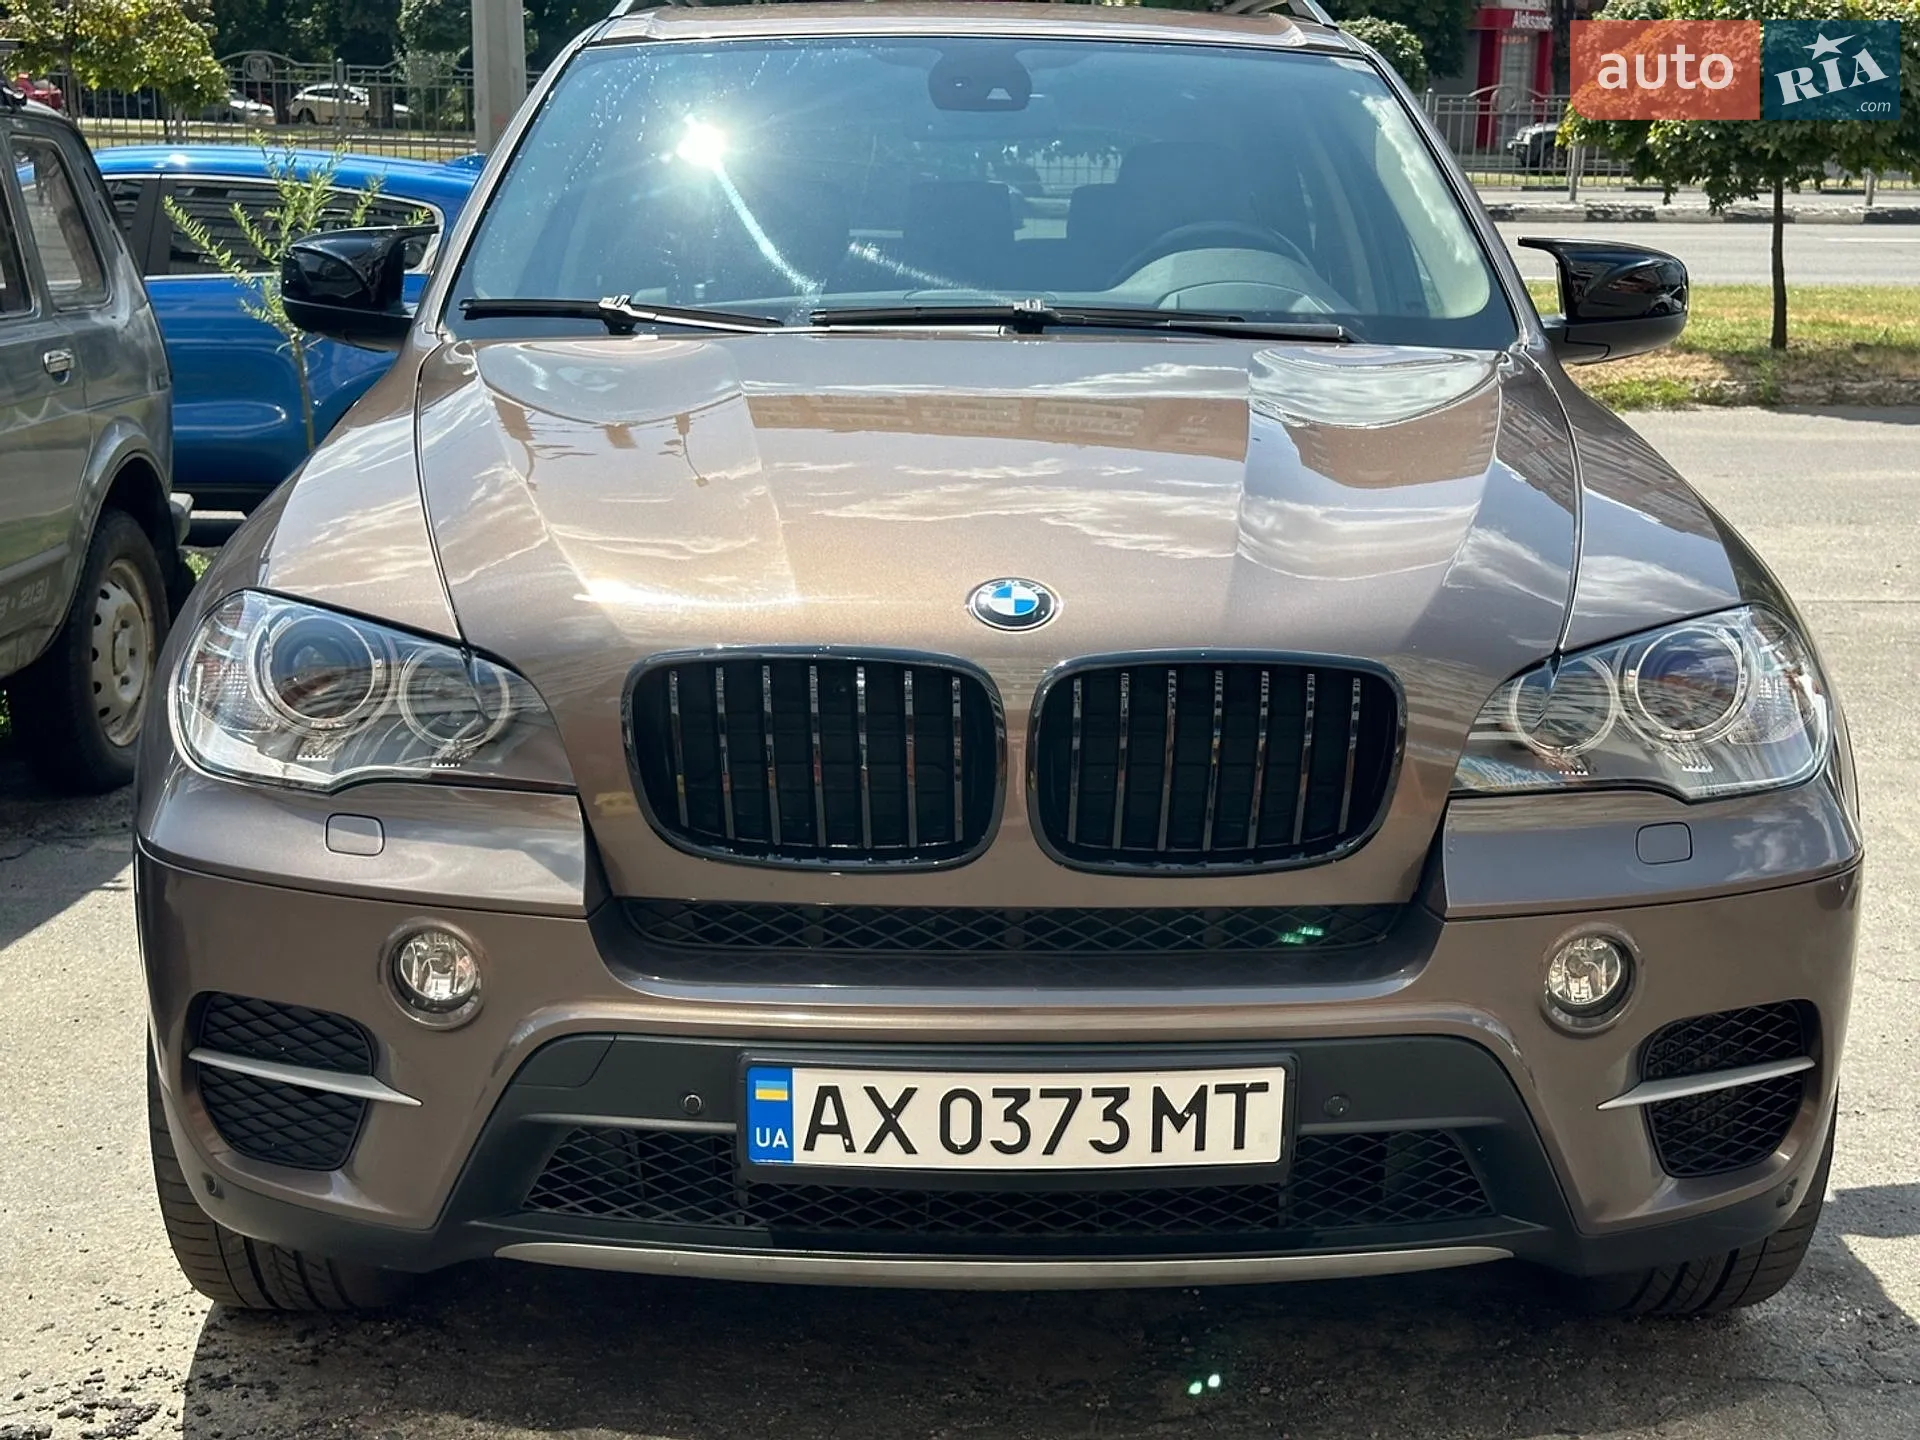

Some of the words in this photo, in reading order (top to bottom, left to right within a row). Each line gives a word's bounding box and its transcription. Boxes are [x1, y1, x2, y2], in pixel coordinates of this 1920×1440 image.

[755, 1128, 789, 1148] UA
[802, 1085, 919, 1155] AX
[938, 1086, 1132, 1155] 0373
[1150, 1081, 1269, 1153] MT
